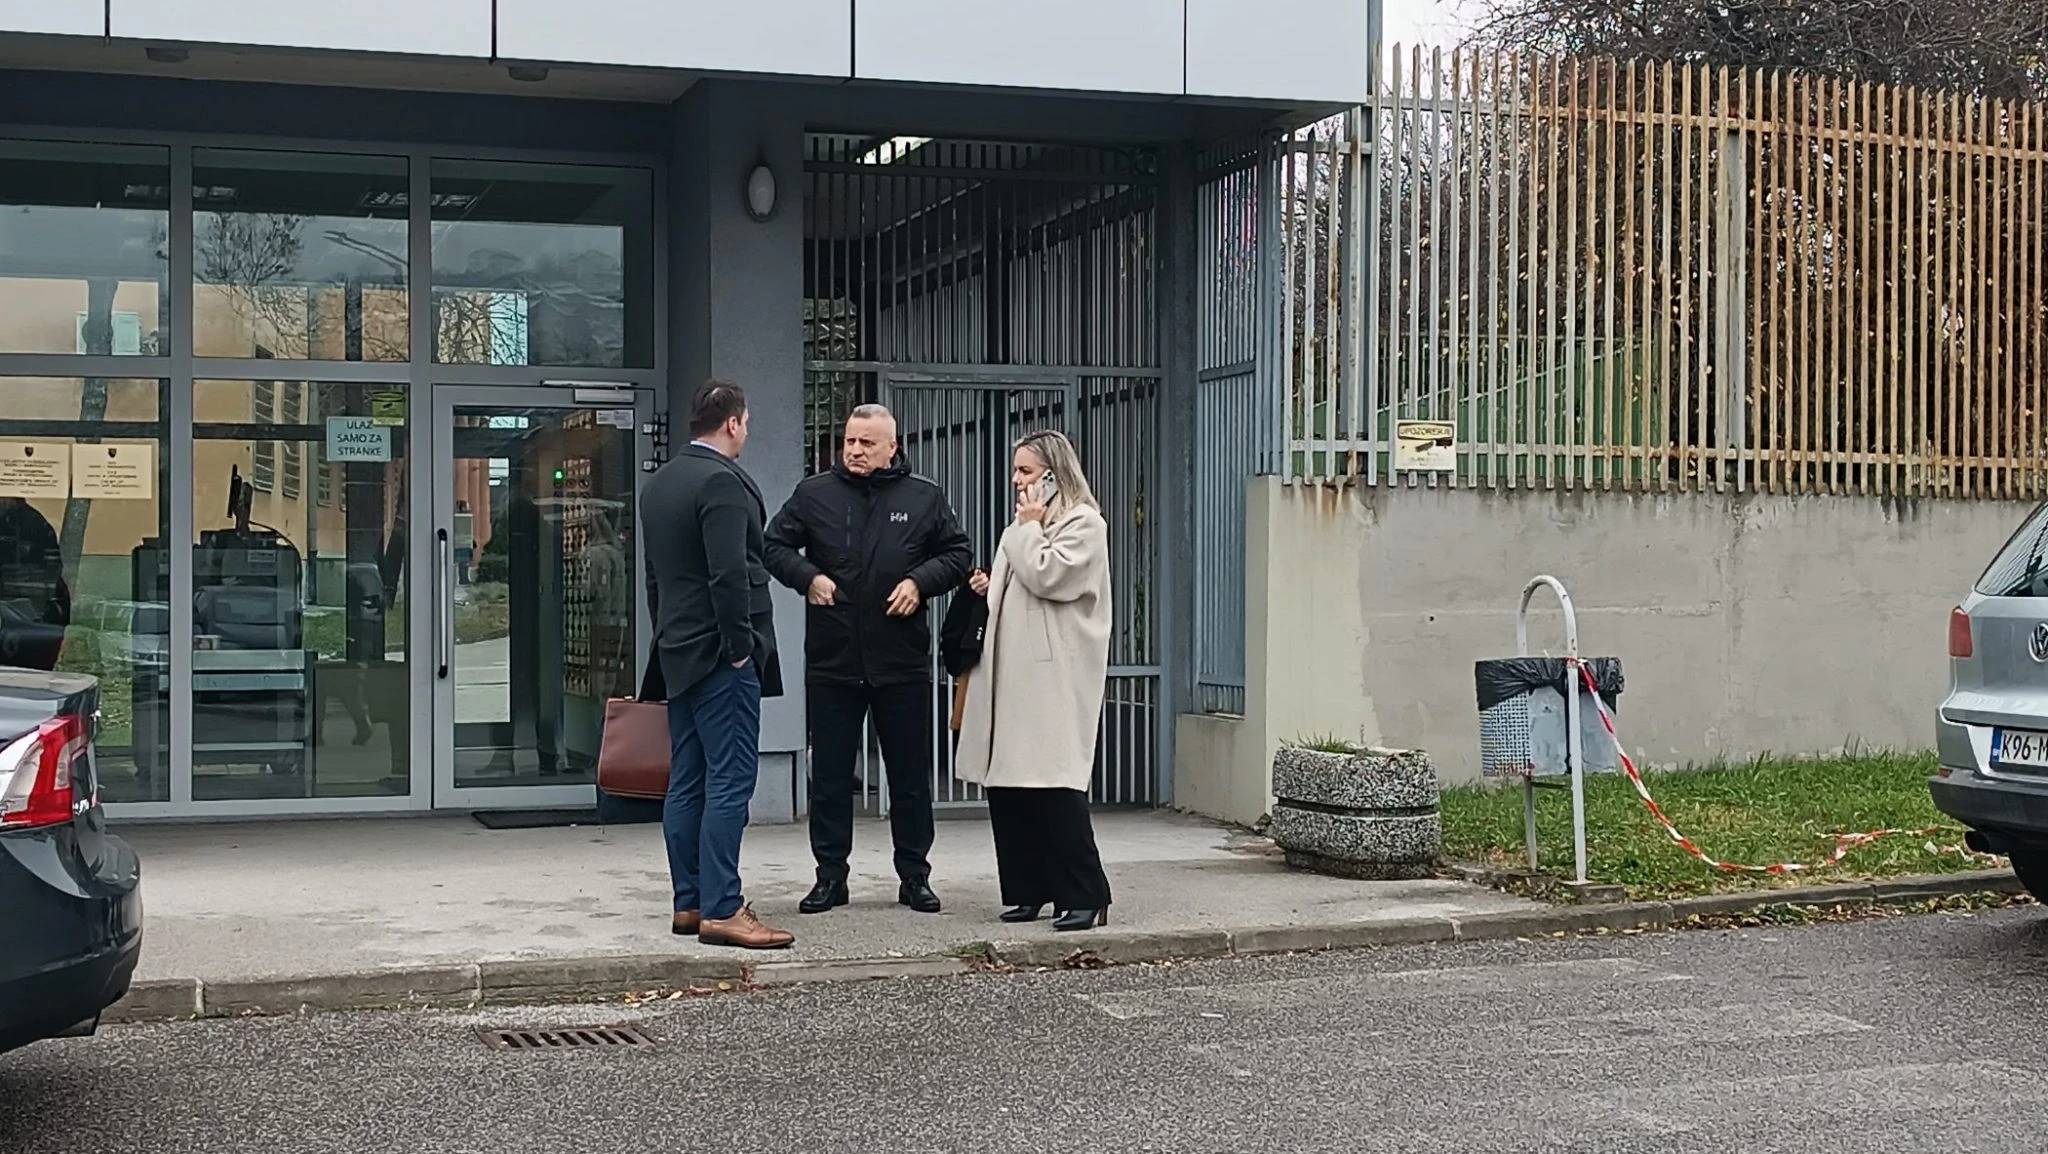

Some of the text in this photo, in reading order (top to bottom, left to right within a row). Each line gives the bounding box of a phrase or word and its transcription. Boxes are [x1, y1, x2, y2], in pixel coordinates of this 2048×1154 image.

[346, 420, 373, 430] ULAZ
[337, 433, 382, 443] SAMO ZA
[337, 447, 382, 456] STRANKE
[2001, 733, 2048, 762] K96-M
